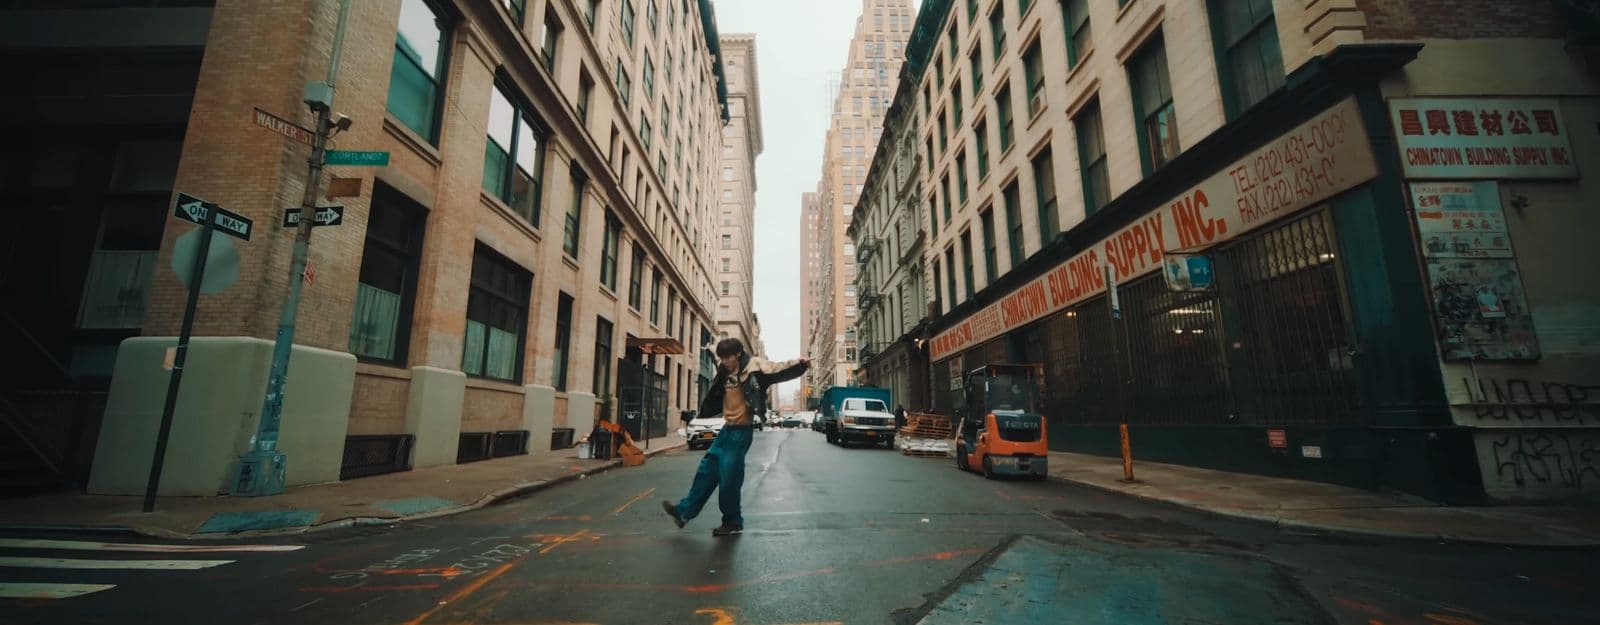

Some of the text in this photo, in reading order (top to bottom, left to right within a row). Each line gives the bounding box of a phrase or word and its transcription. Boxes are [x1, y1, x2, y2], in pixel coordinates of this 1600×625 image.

[257, 111, 312, 144] WALKER ST
[1399, 109, 1560, 136] 昌興建材公司
[333, 151, 383, 161] CORTLANDT
[1406, 147, 1463, 166] CHINATOWN
[1465, 147, 1511, 166] BUILDING
[1512, 147, 1548, 166] SUPPLY
[189, 205, 244, 231] ON WAY
[317, 212, 335, 220] WAY
[1001, 280, 1048, 329] CHINATOWN
[1047, 250, 1104, 307] BUILDING
[1104, 213, 1166, 282] SUPPLY
[1171, 190, 1227, 249] INC.
[1005, 420, 1039, 429] TOYOTA
